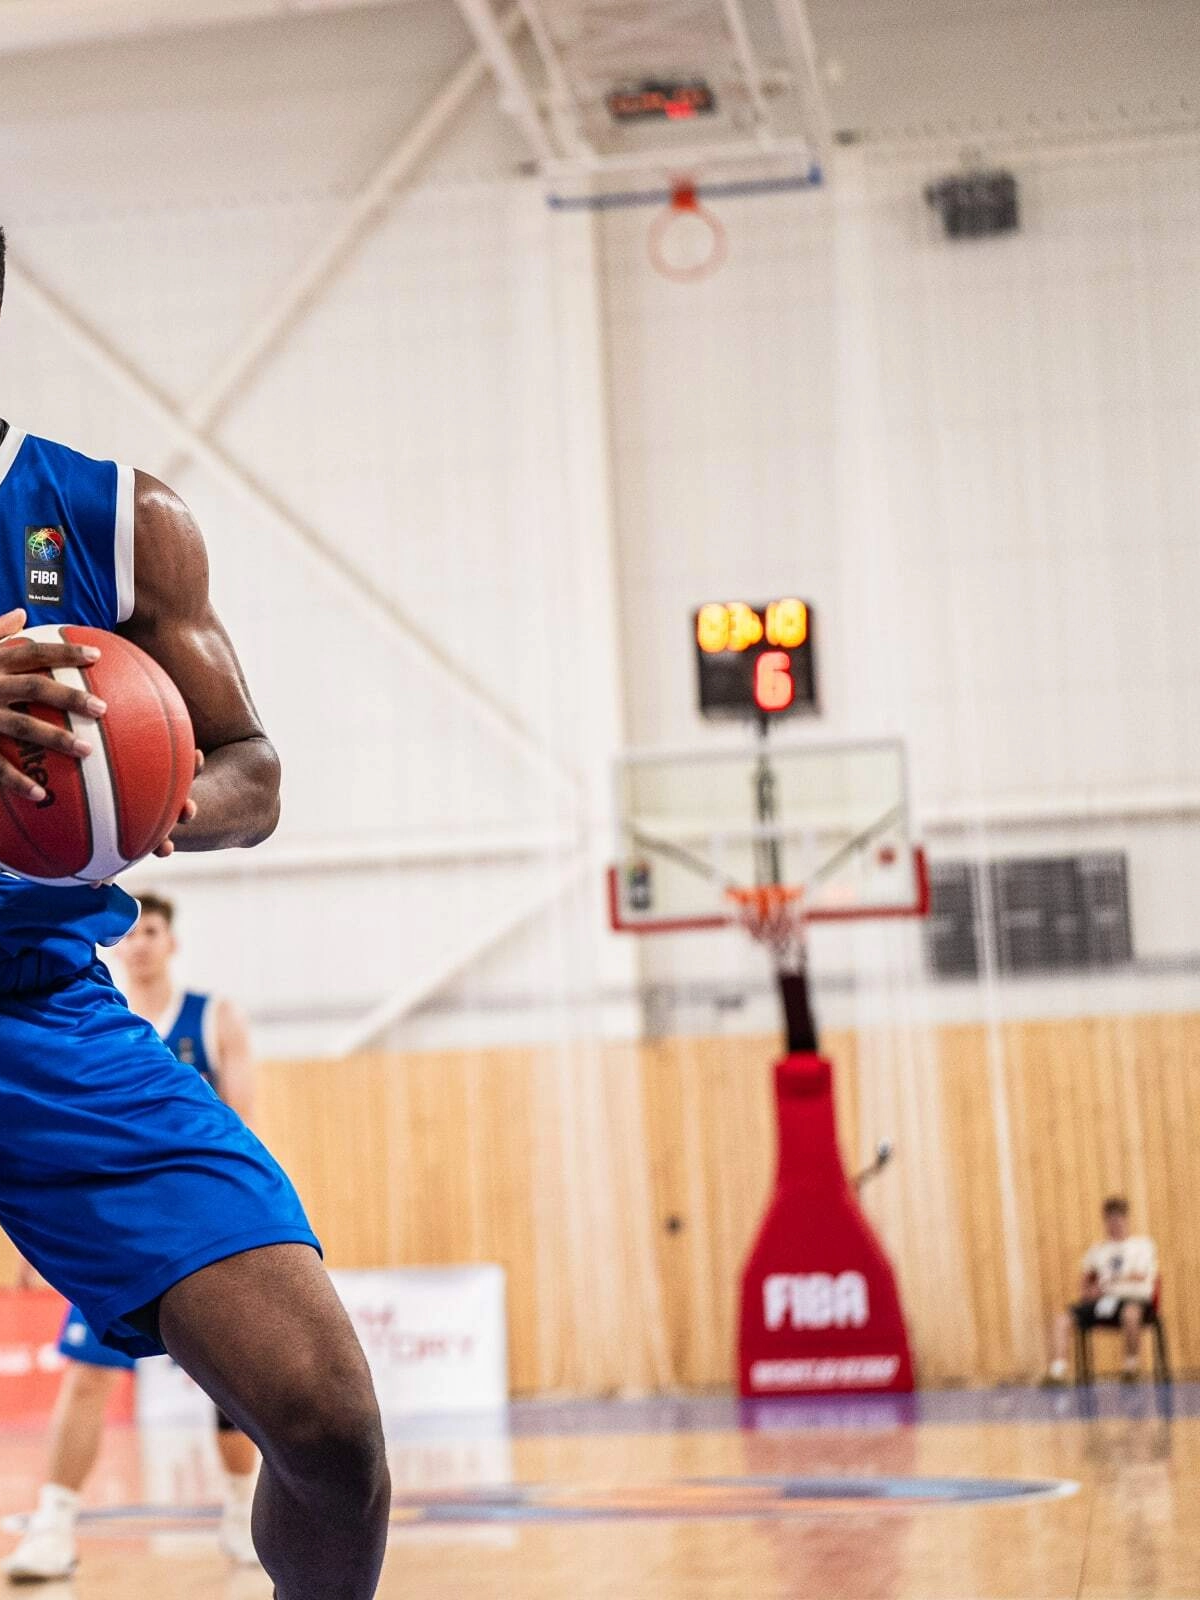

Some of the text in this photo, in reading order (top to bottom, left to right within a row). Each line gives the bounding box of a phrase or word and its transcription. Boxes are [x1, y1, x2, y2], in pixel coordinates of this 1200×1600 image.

[30, 570, 58, 585] FIBA
[755, 650, 796, 712] 6
[762, 1270, 870, 1331] FIBA
